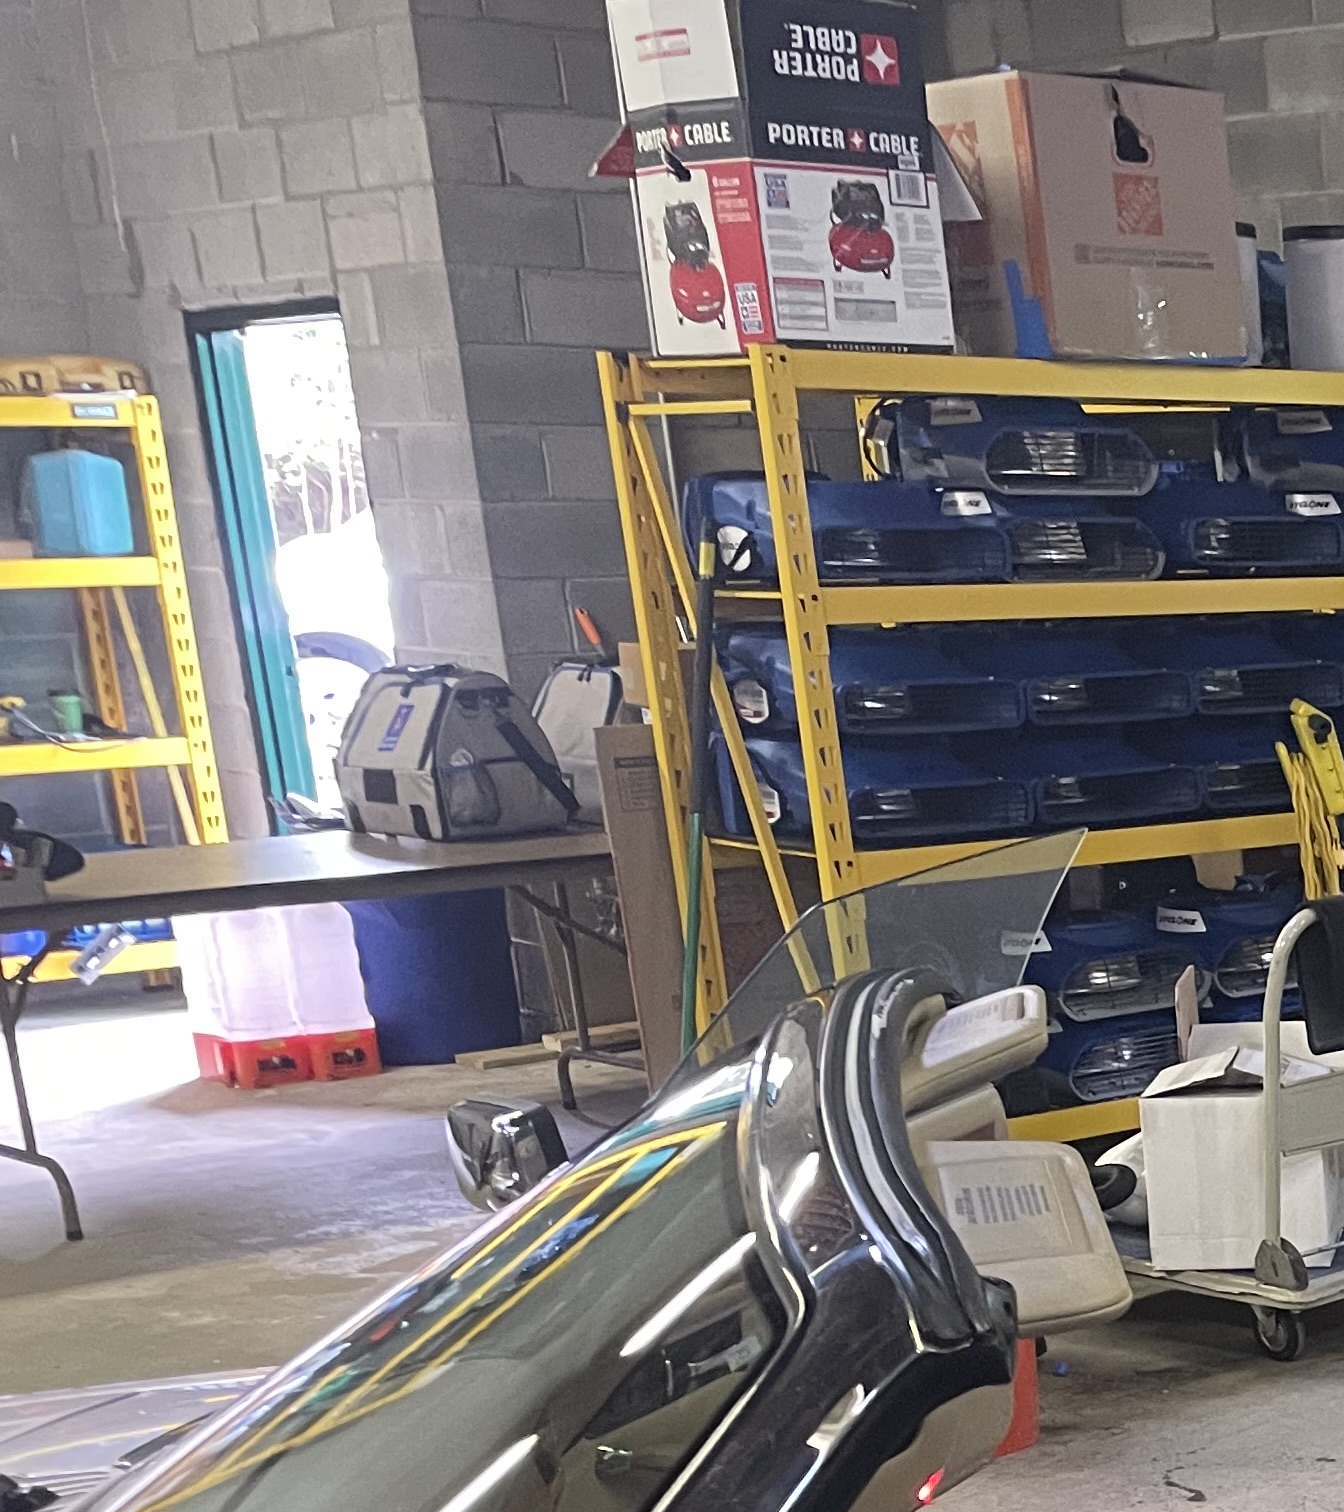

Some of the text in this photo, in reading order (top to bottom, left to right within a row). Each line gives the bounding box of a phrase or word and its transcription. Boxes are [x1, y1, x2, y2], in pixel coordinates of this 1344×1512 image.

[789, 23, 858, 54] CABLE
[773, 49, 861, 83] PORTER
[684, 122, 731, 146] CABLE
[768, 122, 920, 156] PORTER CABLE
